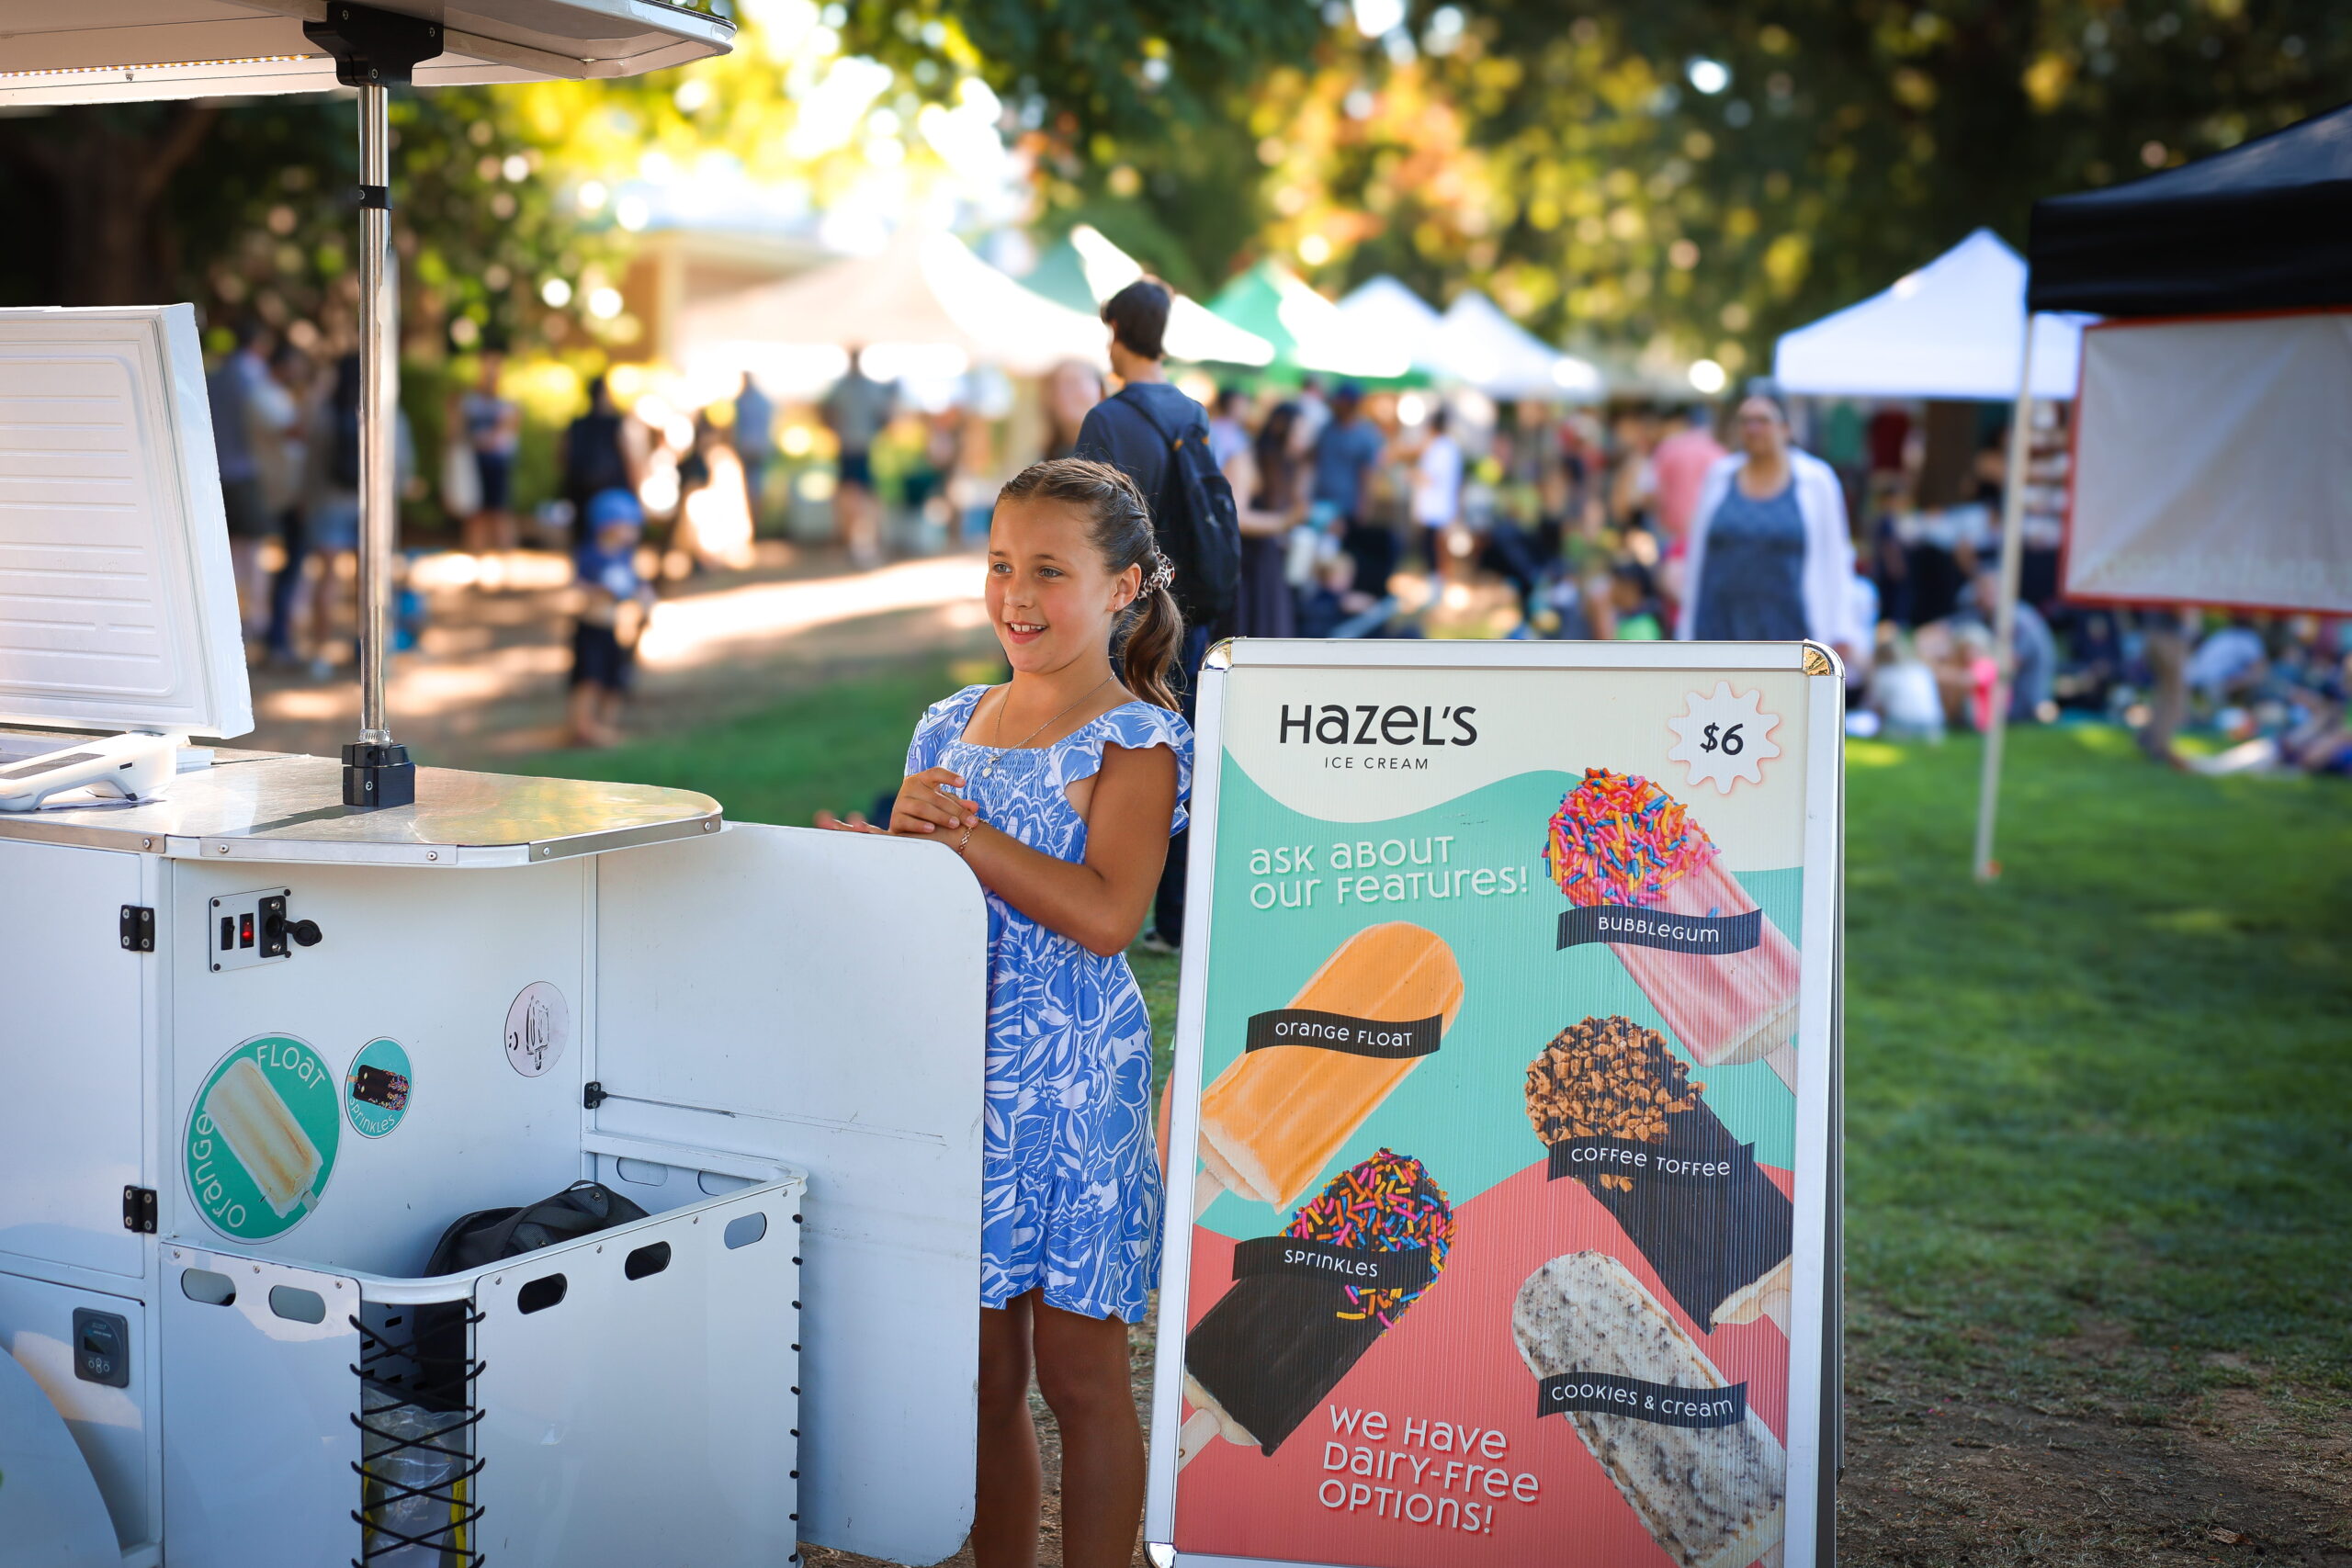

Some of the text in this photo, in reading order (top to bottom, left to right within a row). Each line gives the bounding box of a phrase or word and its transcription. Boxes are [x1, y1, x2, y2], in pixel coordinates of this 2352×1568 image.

[1700, 722, 1744, 756] $6
[1324, 756, 1429, 770] ICE CREAM
[1644, 1395, 1655, 1410] &
